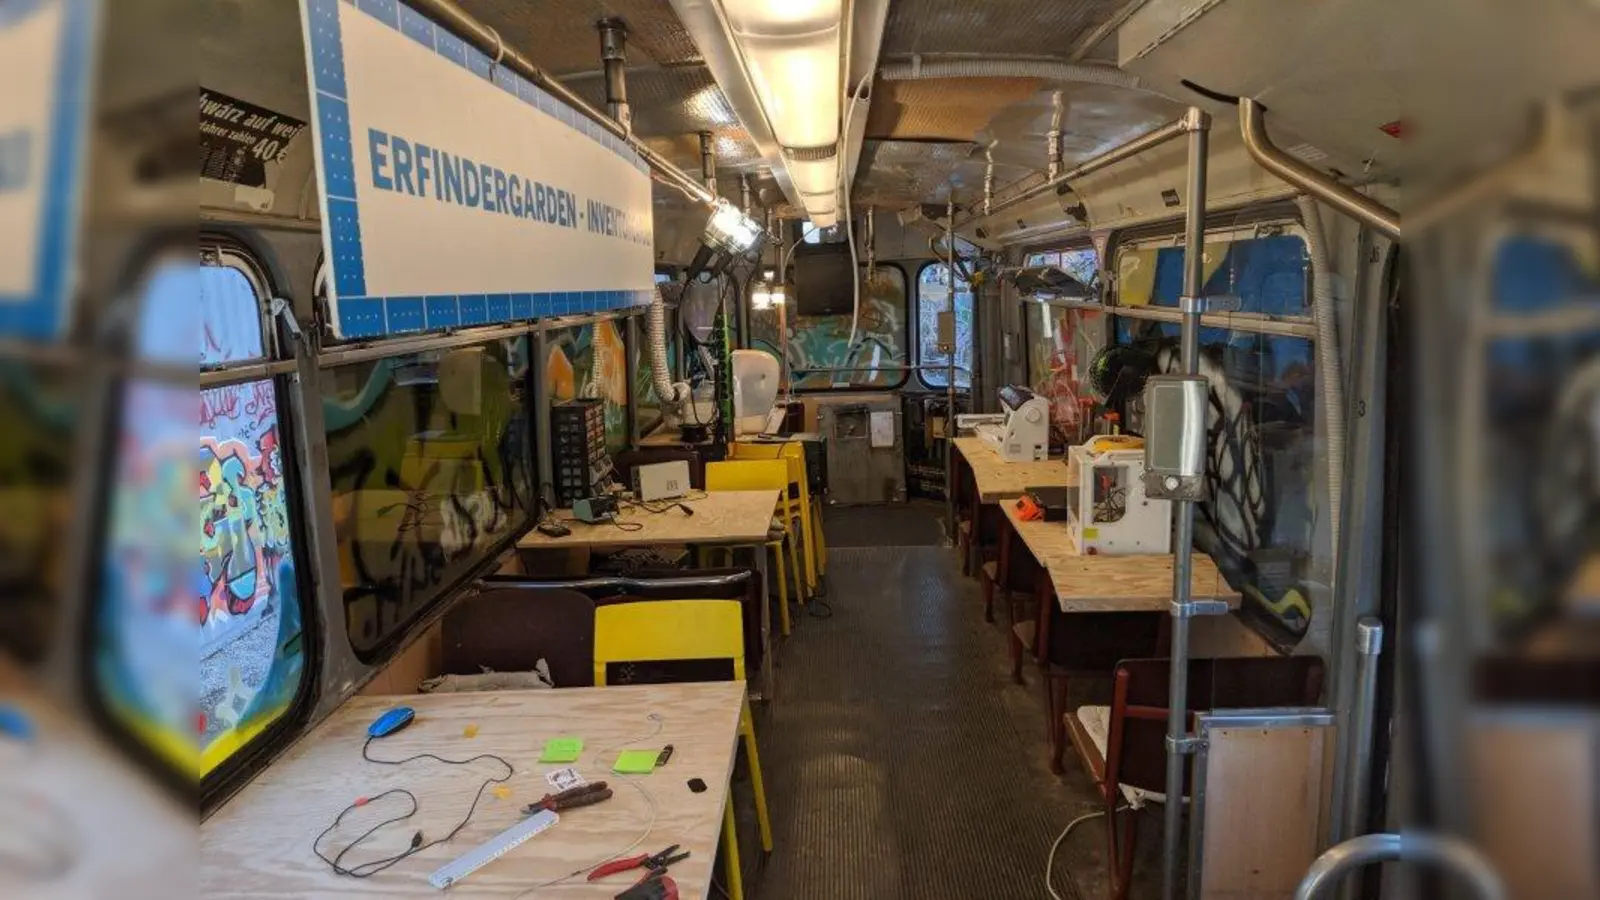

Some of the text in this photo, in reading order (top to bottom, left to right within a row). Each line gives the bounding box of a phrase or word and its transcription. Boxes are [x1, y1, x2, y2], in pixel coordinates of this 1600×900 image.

[243, 114, 278, 132] auf
[252, 138, 279, 161] 40
[368, 127, 577, 229] ERFINDERGARDEN
